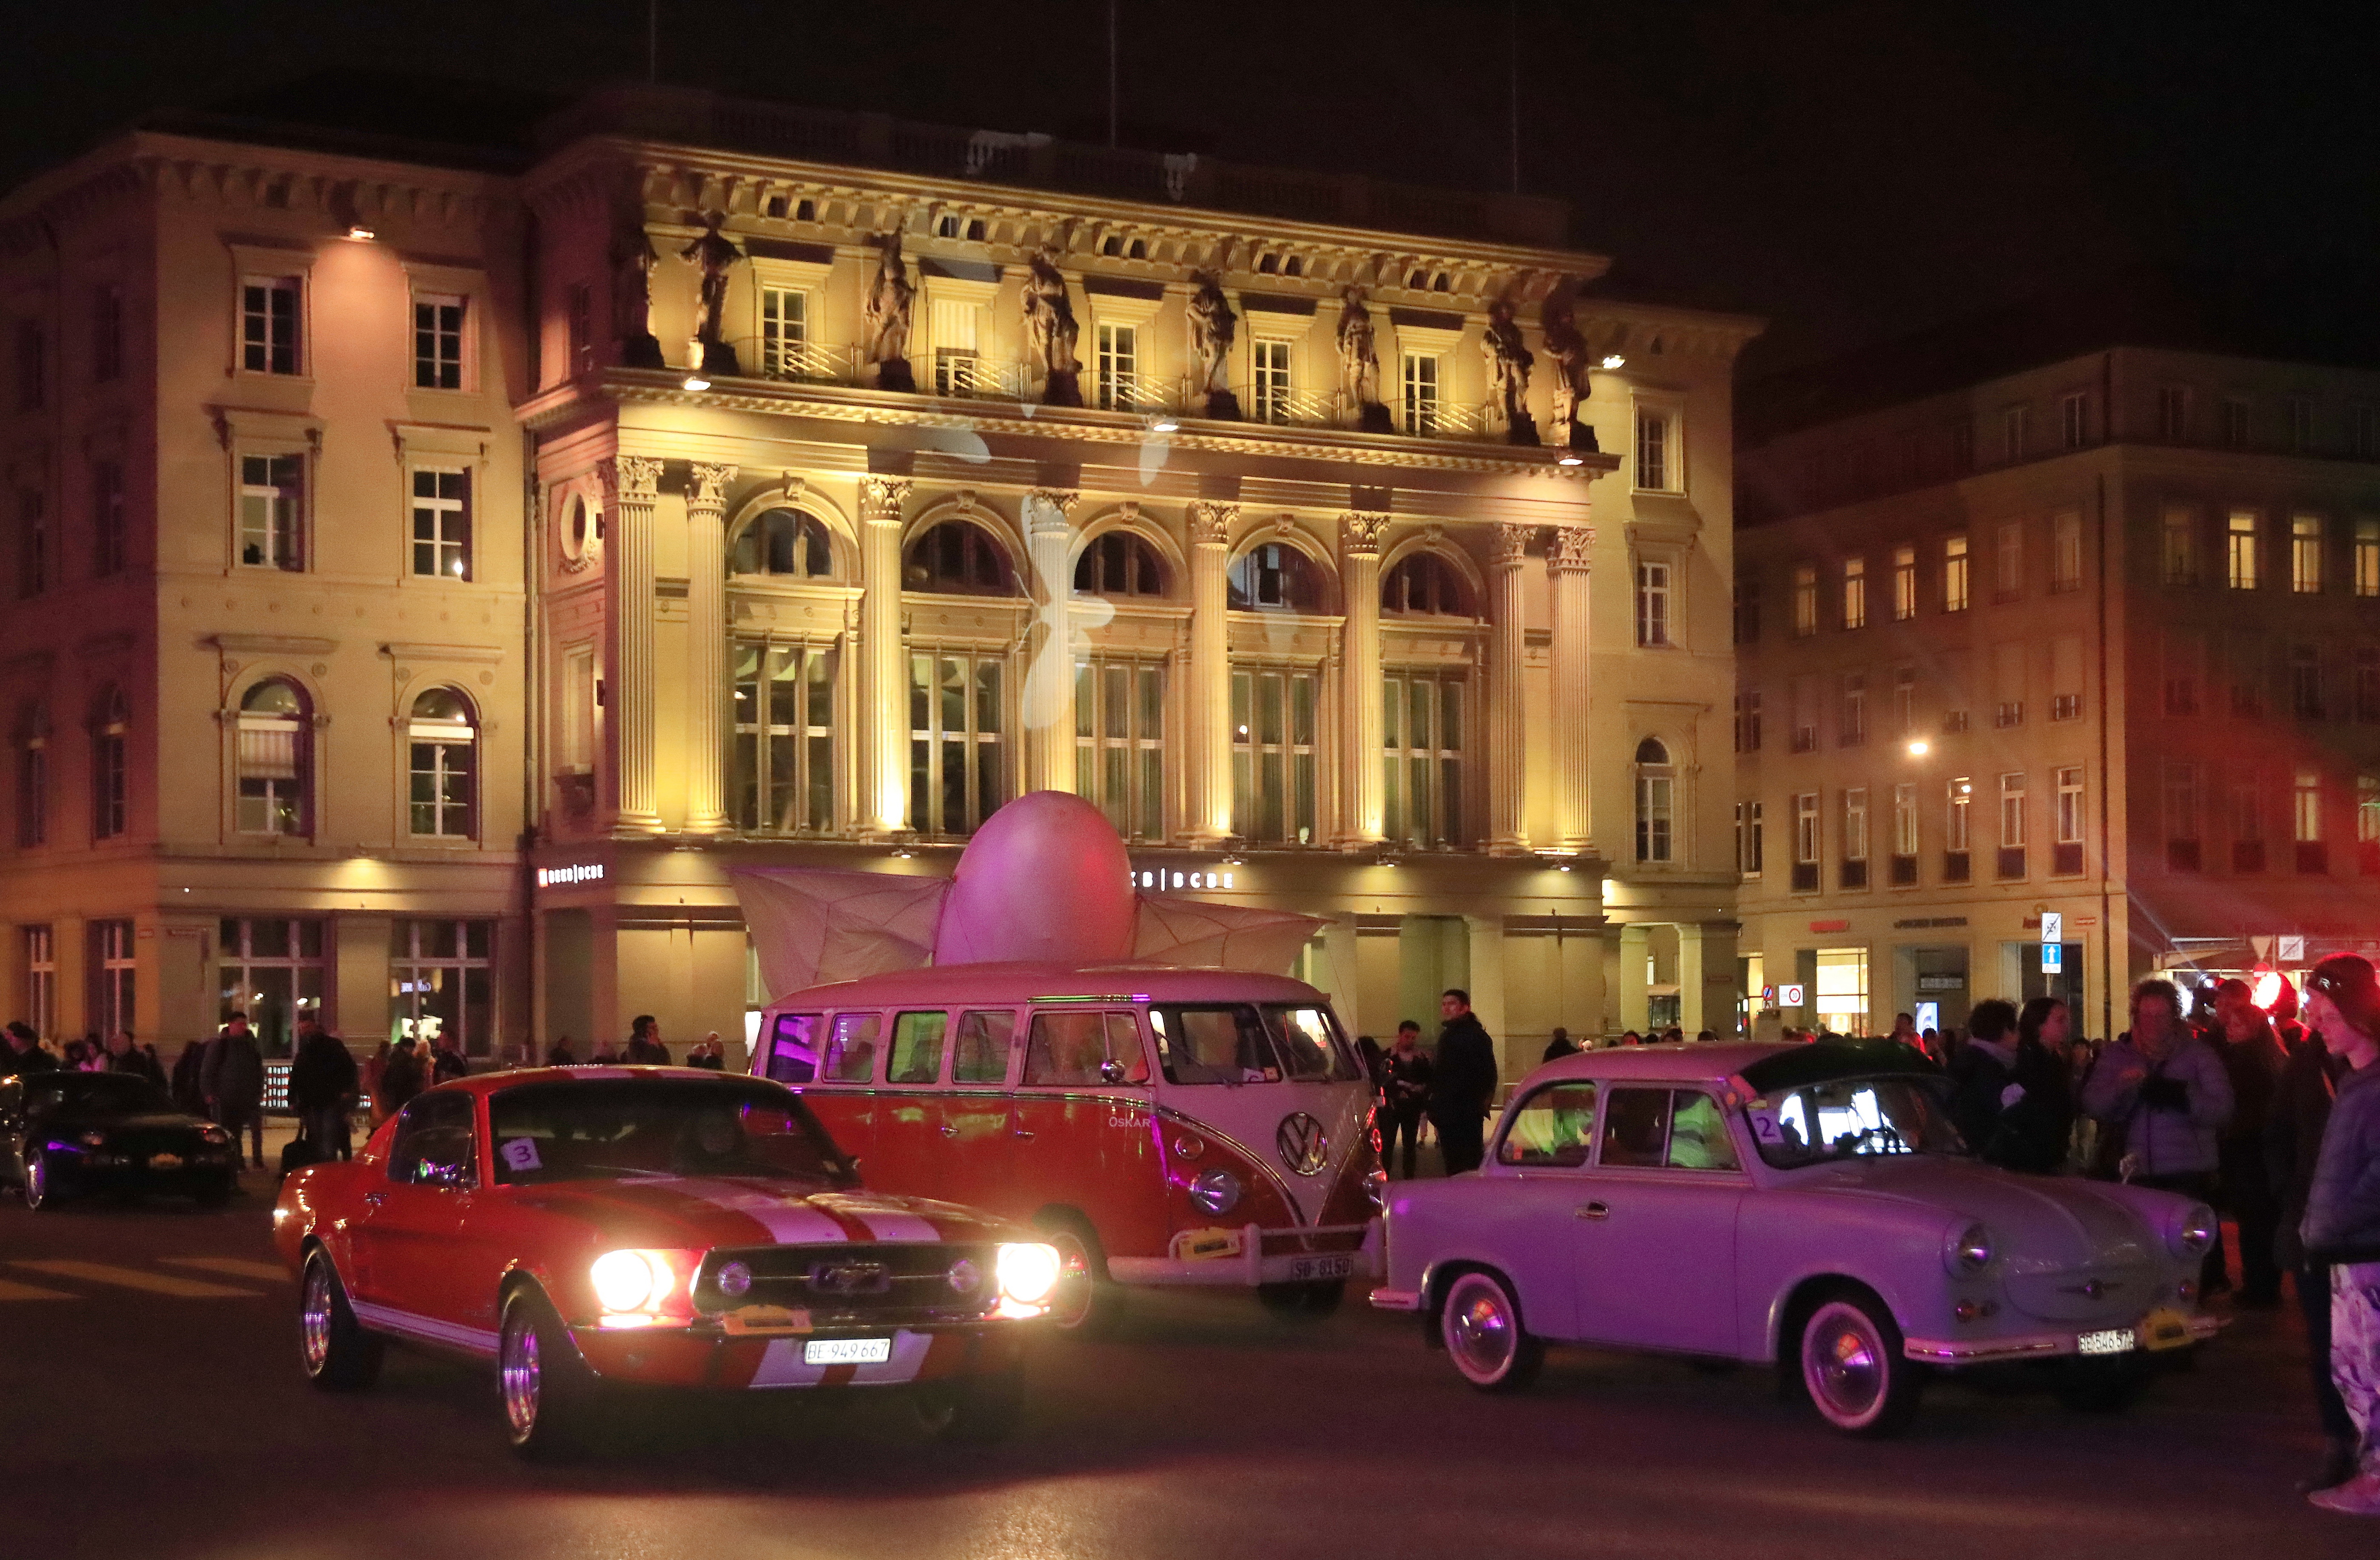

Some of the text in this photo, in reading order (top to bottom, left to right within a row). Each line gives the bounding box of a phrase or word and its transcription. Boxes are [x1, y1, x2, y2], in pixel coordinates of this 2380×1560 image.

[1109, 1117, 1151, 1127] OSKAR
[1756, 1117, 1777, 1137] 2
[514, 1145, 532, 1163] 3
